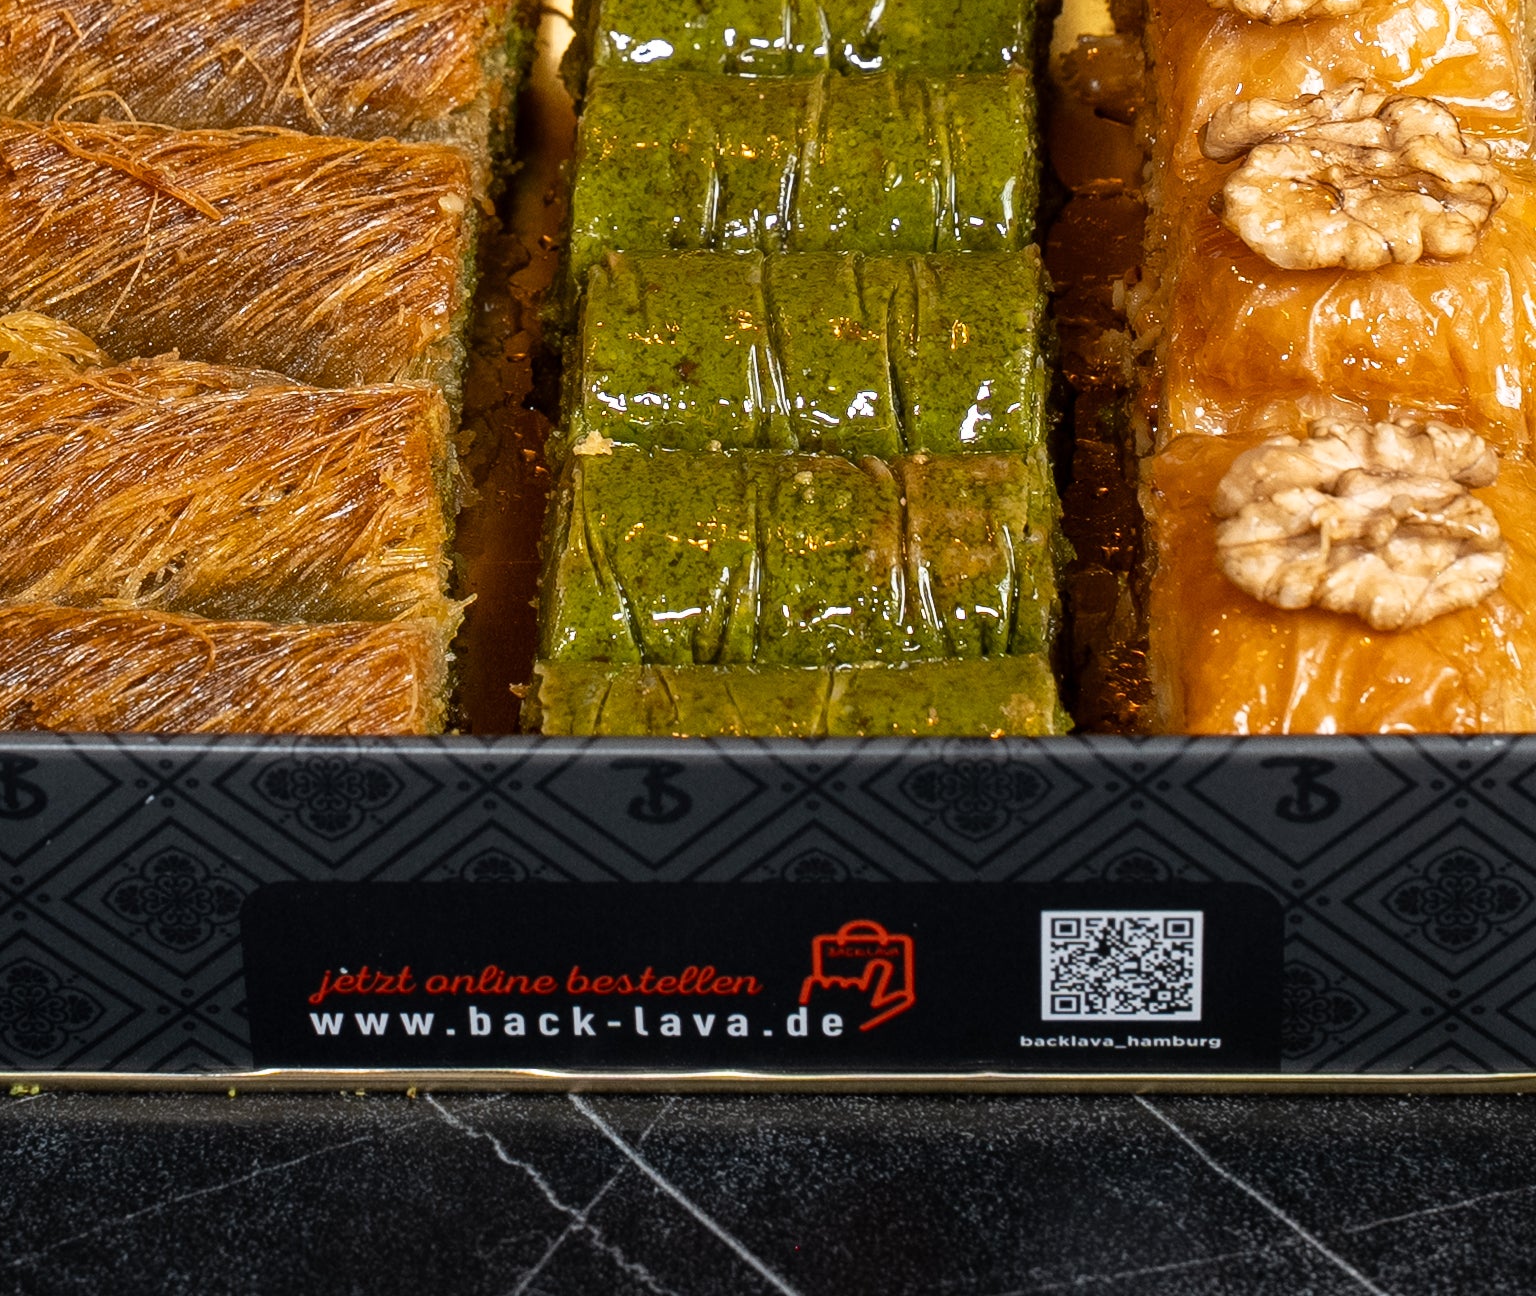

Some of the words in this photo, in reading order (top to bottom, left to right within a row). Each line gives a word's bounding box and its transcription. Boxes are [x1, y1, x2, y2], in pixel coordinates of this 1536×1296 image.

[308, 964, 416, 1005] jetzt
[424, 964, 558, 996] online
[565, 965, 763, 997] bestellen
[309, 1005, 844, 1037] www.back-lava.de
[1019, 1035, 1222, 1049] backlava_hamburg
